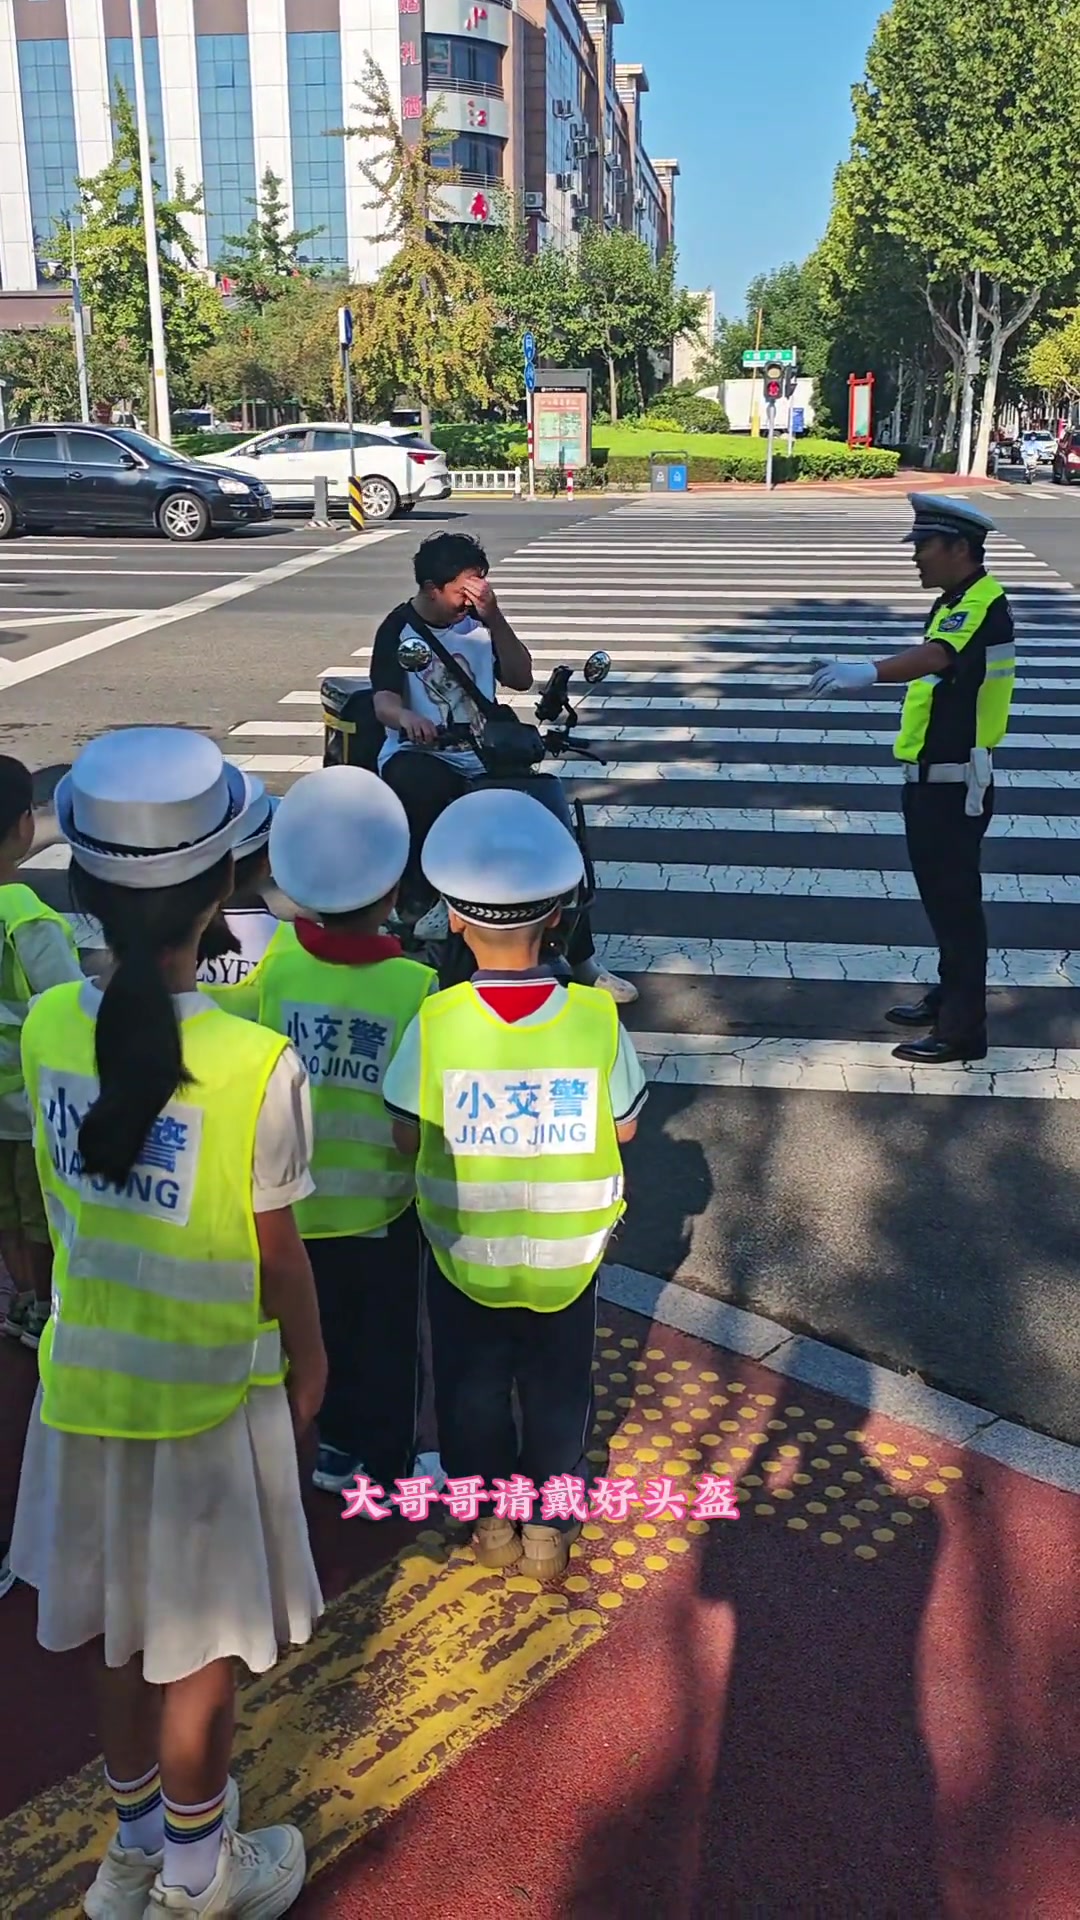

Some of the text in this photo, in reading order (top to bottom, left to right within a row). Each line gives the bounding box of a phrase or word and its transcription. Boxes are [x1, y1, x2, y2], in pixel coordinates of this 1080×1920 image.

[287, 1011, 388, 1061] 小交警
[321, 1056, 380, 1084] JING
[455, 1078, 589, 1120] 小交警
[48, 1086, 188, 1173] 小警
[455, 1122, 587, 1146] JIAO JING
